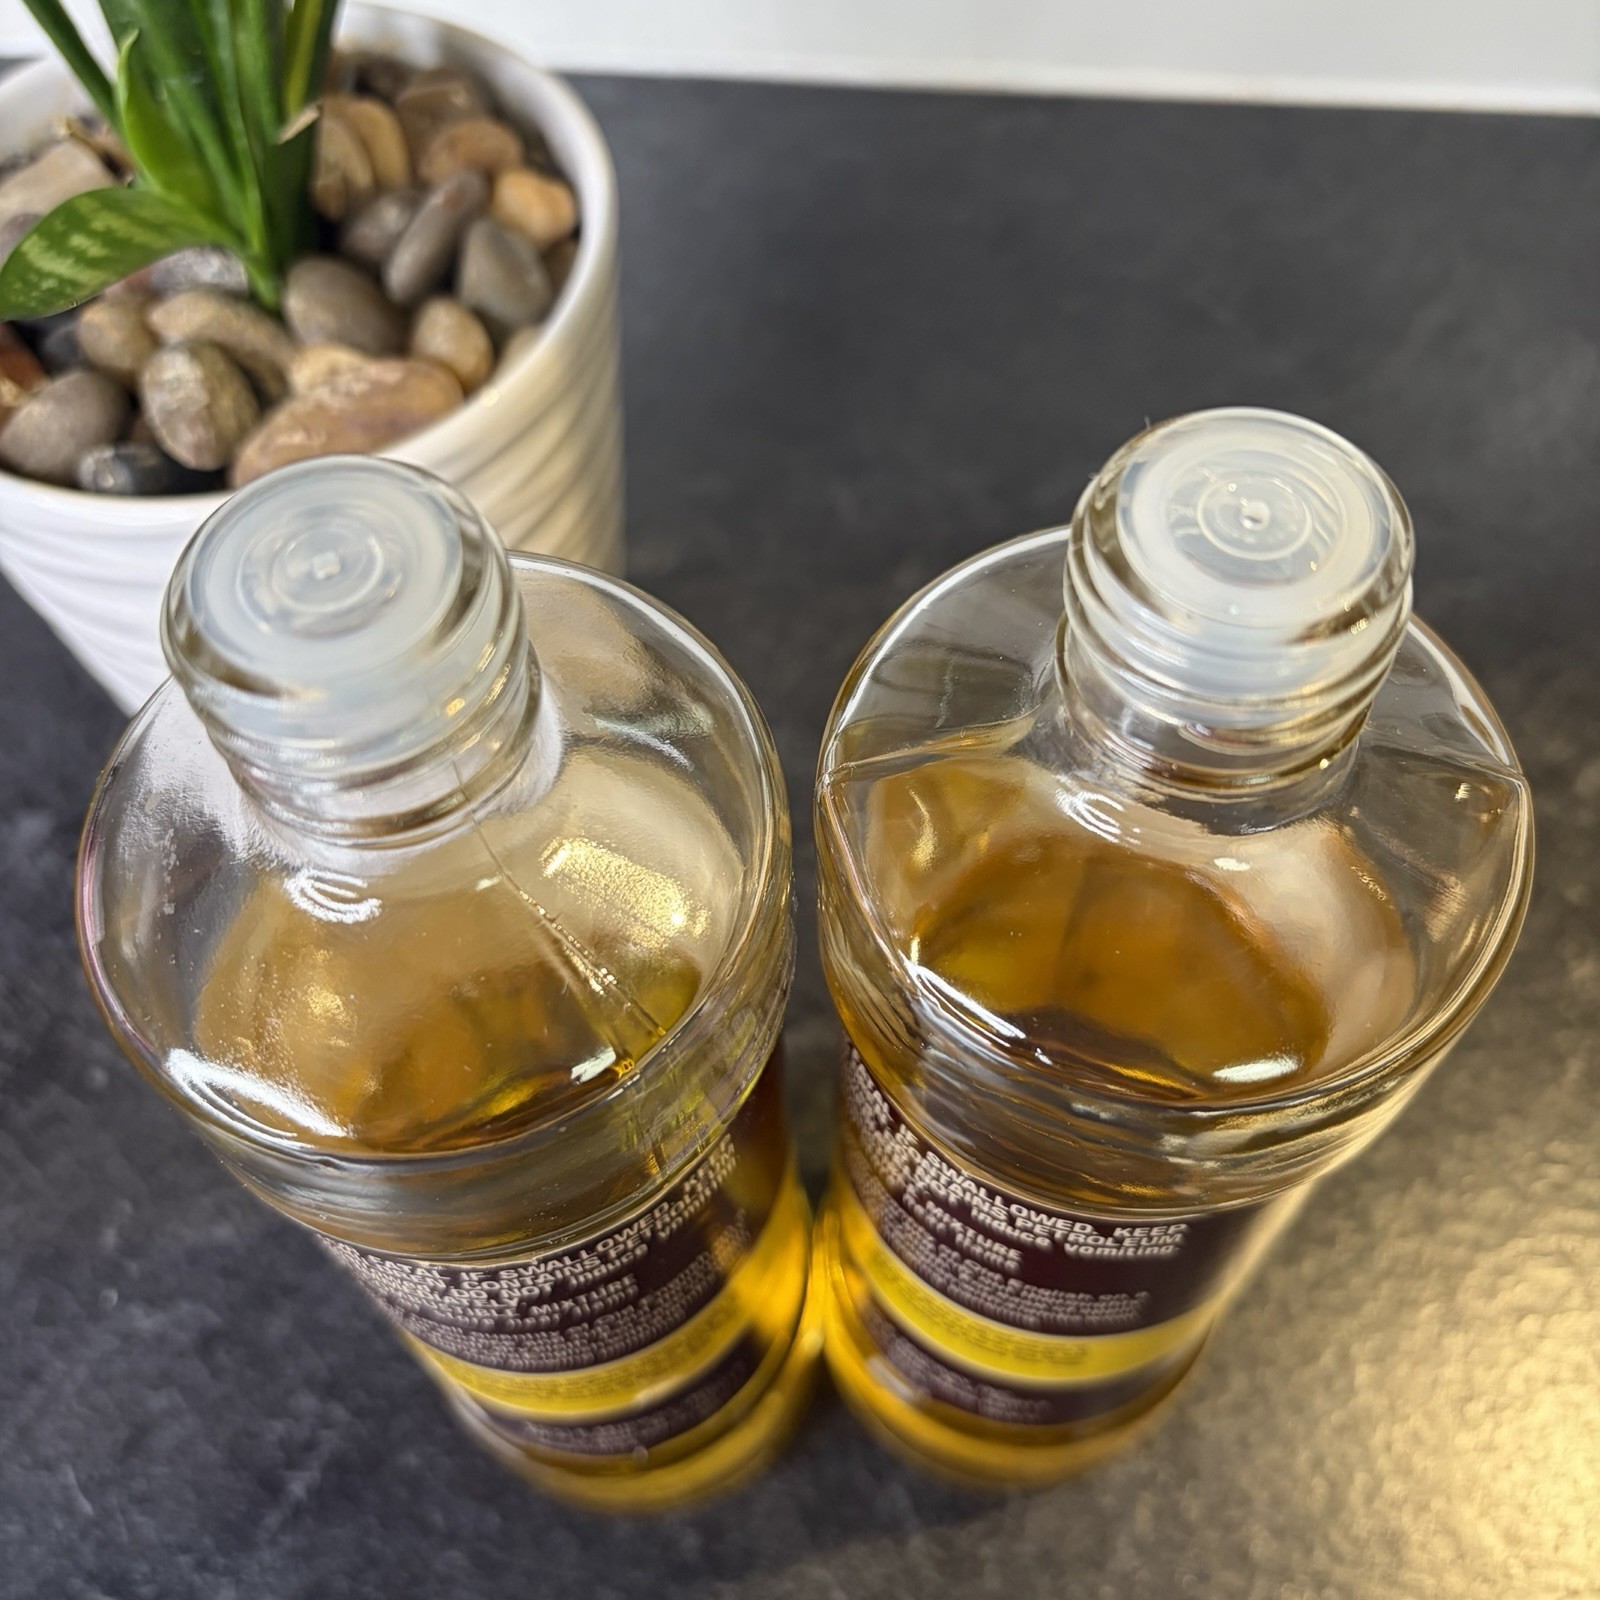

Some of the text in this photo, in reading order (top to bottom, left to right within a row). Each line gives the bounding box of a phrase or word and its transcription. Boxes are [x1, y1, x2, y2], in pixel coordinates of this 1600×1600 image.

[970, 1205, 1052, 1251] induce
[1014, 1216, 1184, 1250] PETROLEUM
[1112, 1223, 1189, 1240] KEEP
[367, 1254, 451, 1282] FATAL
[459, 1271, 488, 1284] IF
[462, 1255, 602, 1293] CONTAINS
[500, 1282, 554, 1302] NOT
[569, 1243, 648, 1292] induce
